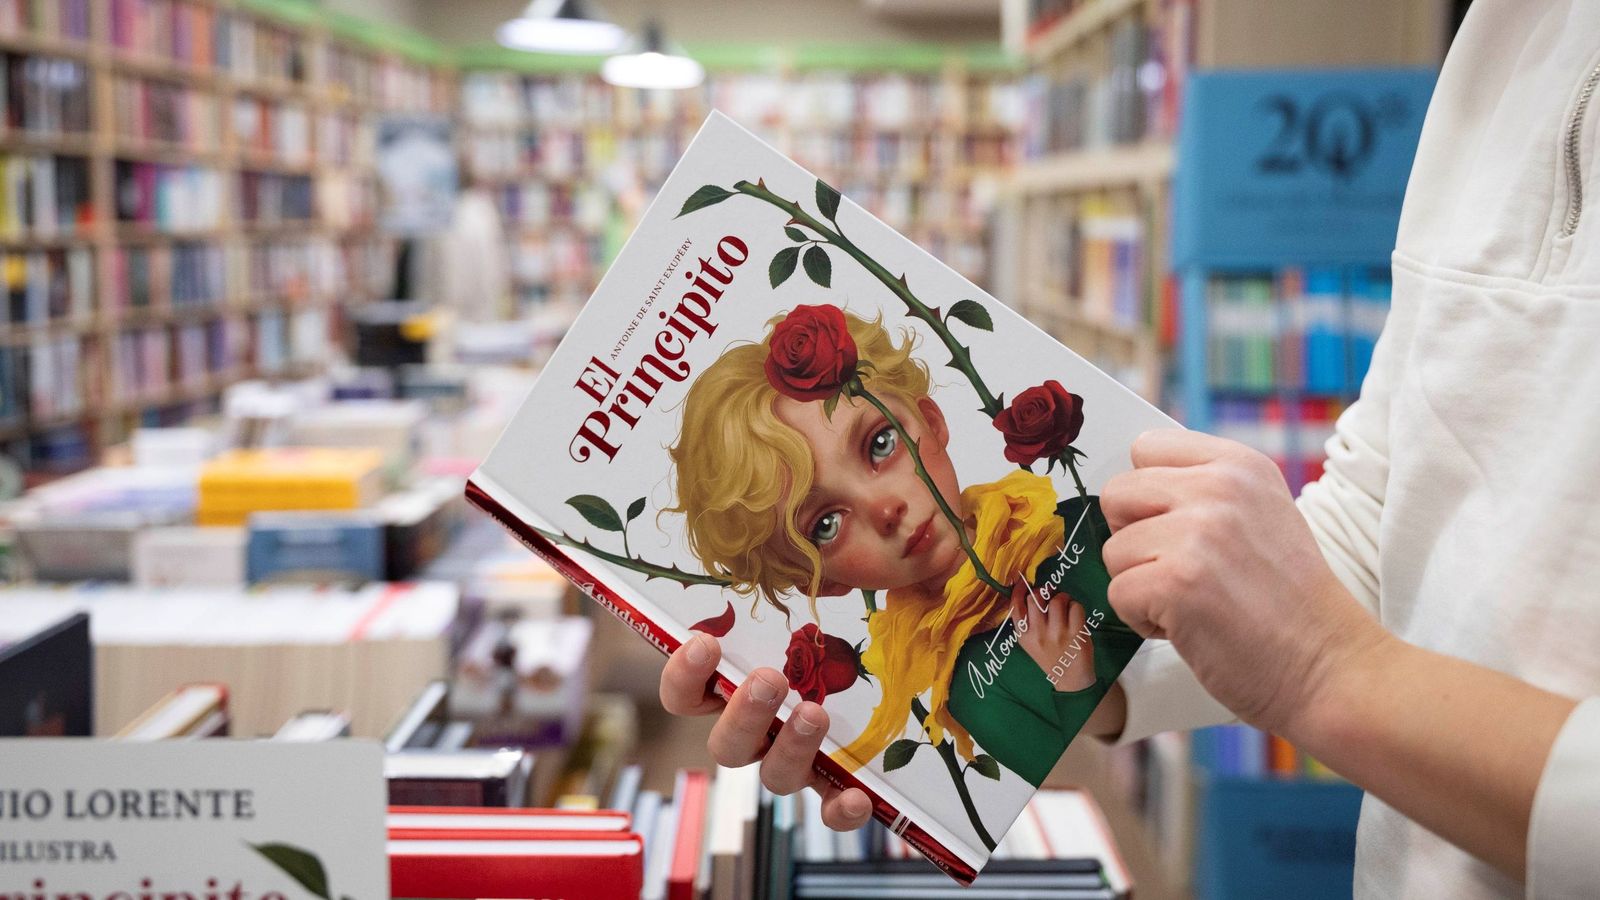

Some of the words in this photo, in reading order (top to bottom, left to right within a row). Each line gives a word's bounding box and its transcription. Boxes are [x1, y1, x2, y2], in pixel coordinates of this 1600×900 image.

[568, 235, 749, 464] Principito
[609, 318, 640, 361] ANTOINE
[636, 306, 648, 321] DE
[644, 236, 693, 308] SAINT-EXUPÉRY
[573, 355, 622, 408] El
[967, 606, 1028, 699] Antonio
[1018, 502, 1092, 614] Lorente
[1046, 608, 1105, 687] EDELVIVES
[64, 789, 256, 820] LORENTE
